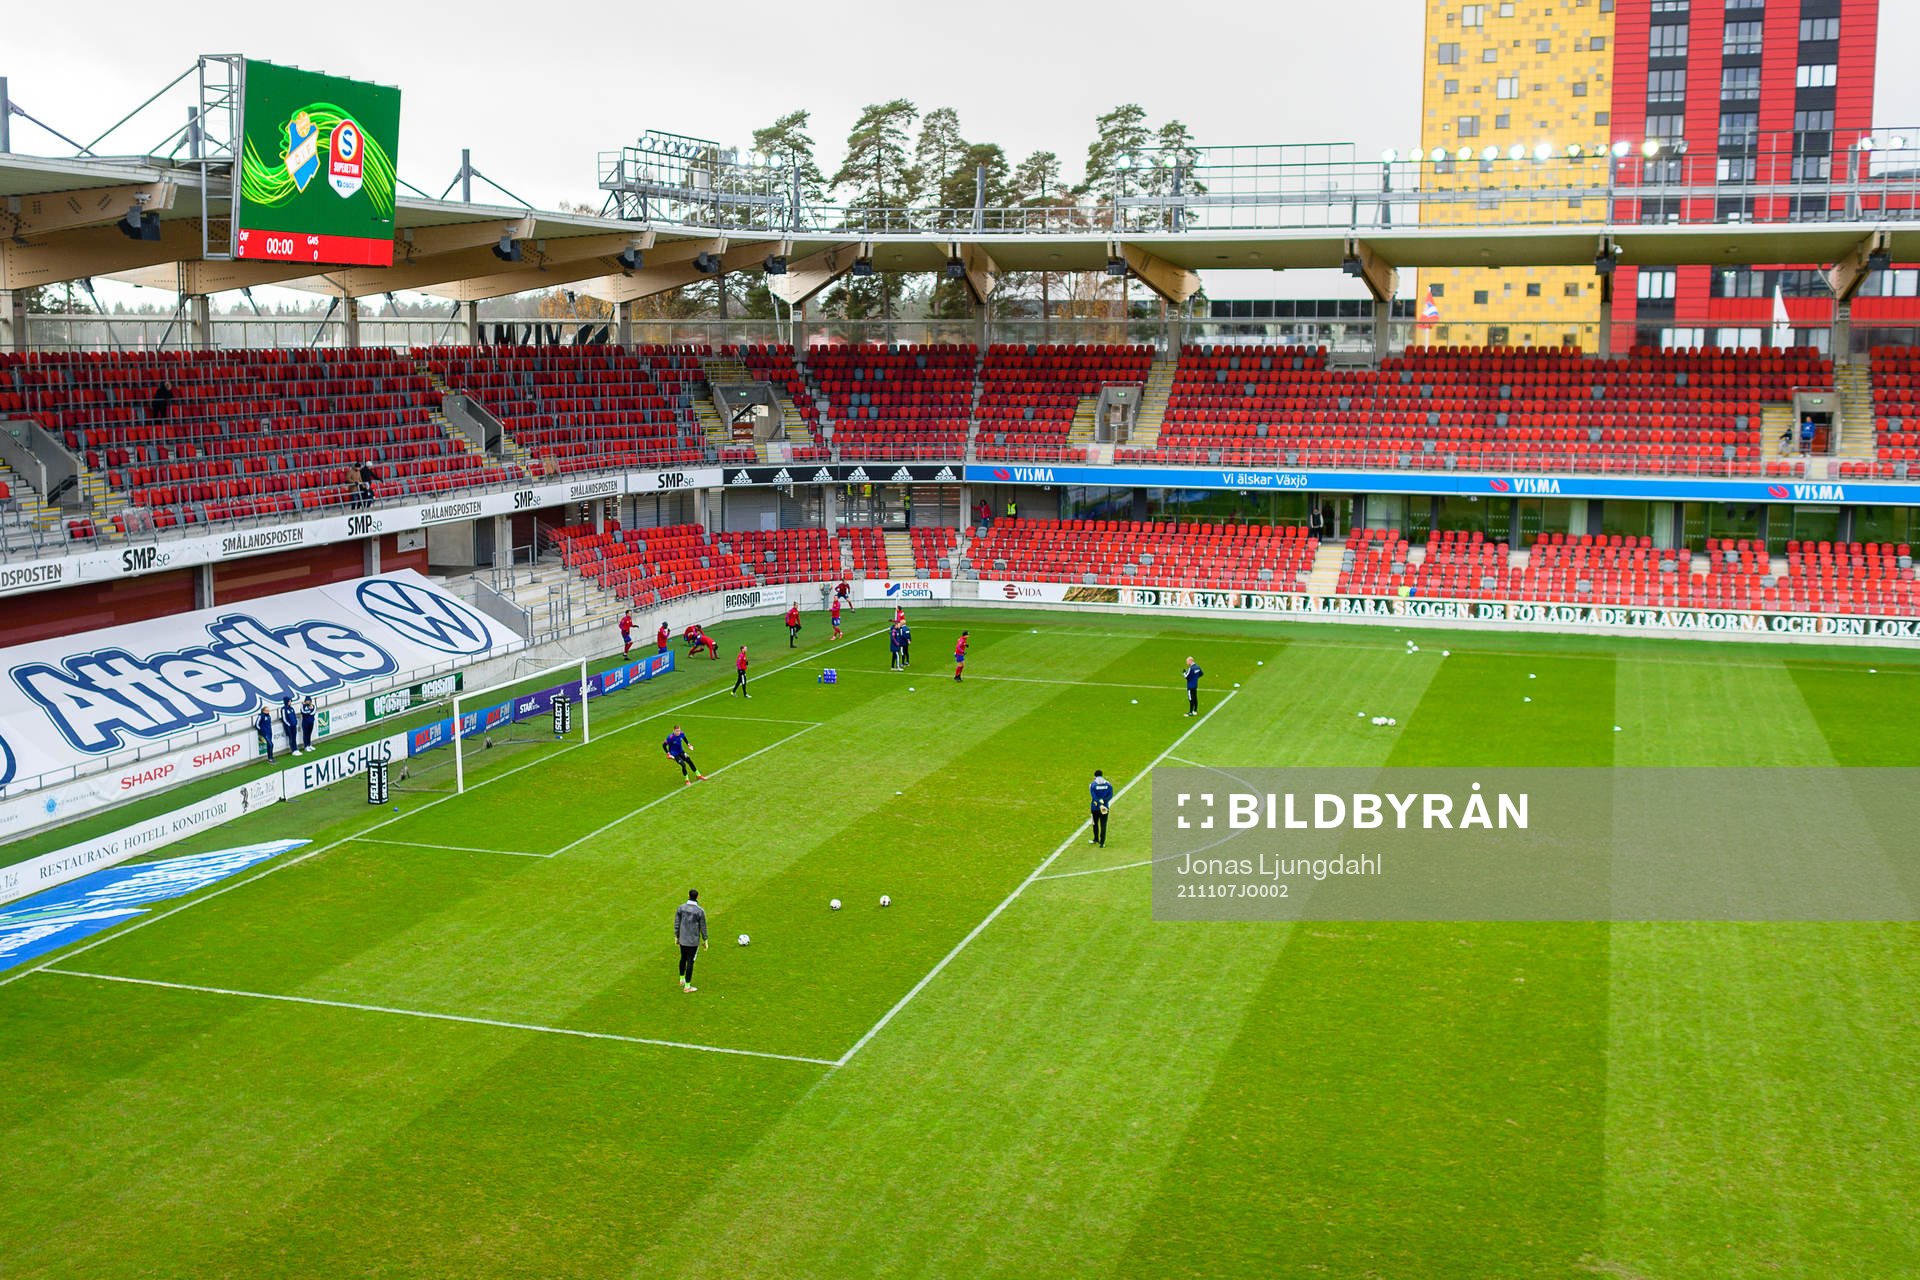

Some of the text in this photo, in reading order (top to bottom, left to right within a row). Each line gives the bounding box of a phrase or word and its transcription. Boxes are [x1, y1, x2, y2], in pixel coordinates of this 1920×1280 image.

[239, 245, 245, 256] 0
[266, 237, 294, 255] 00:00
[313, 249, 319, 261] 0
[1014, 467, 1055, 482] VISMA
[1222, 472, 1309, 489] Vi älskar Växjö
[1513, 478, 1561, 494] VISMA
[1793, 484, 1845, 501] VISMA
[421, 501, 482, 521] SMÅLANDSPOSTEN
[222, 527, 304, 551] SMÅLANDSPOSTEN
[726, 591, 761, 609] ecosign
[902, 589, 929, 597] SPORT
[1018, 586, 1042, 597] VIDA
[1118, 589, 1156, 606] MED
[1250, 594, 1287, 612] DEN
[1479, 603, 1505, 620] DE
[1772, 615, 1818, 633] OCH
[1820, 617, 1865, 635] DEN
[555, 702, 563, 731] SELECT
[193, 744, 241, 768] SHARP
[303, 740, 392, 790] EMILSHUS
[120, 764, 174, 790] SHARP
[370, 766, 379, 800] SELECT
[39, 802, 228, 880] RESTAURANG HOTELL KONDITORI
